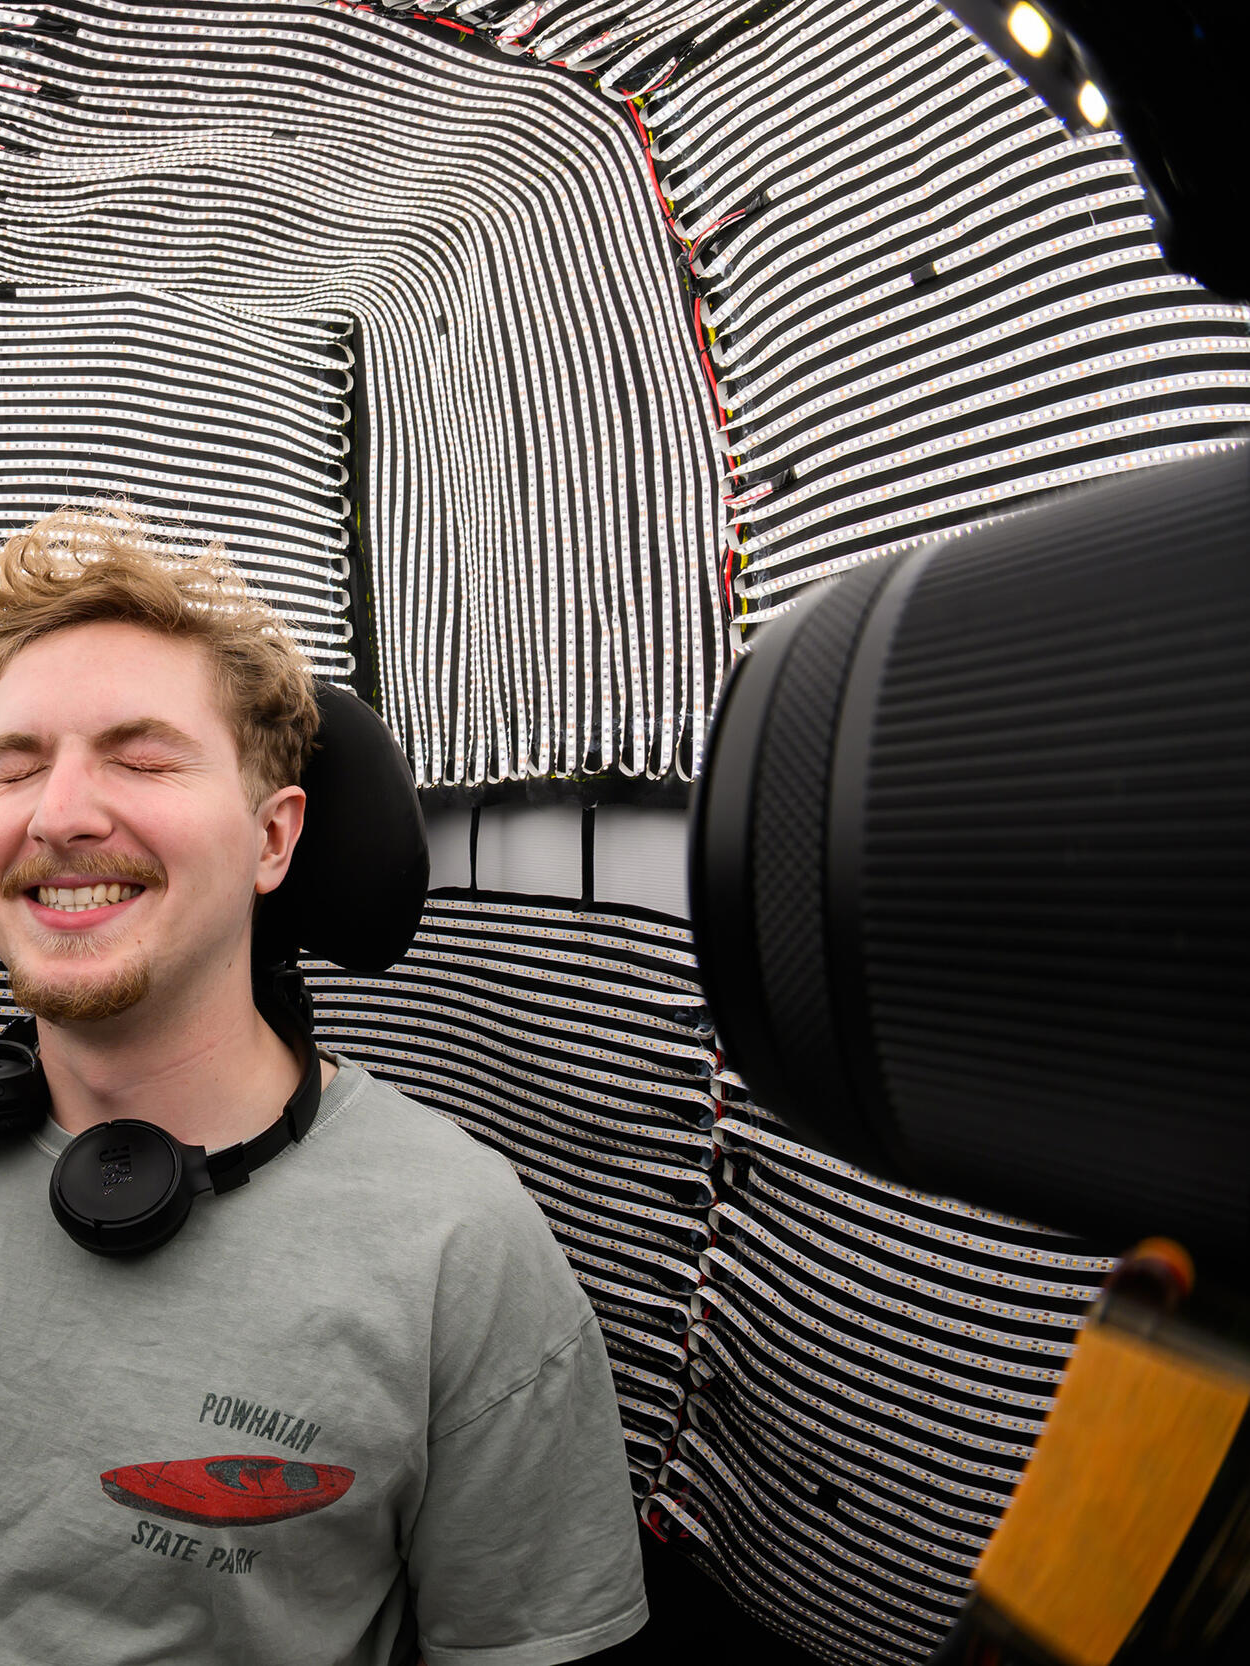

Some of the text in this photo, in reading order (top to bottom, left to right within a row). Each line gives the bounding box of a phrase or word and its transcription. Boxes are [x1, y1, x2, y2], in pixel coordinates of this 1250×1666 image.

[199, 1392, 322, 1454] POWHATAN
[131, 1520, 263, 1574] STATE PARK
